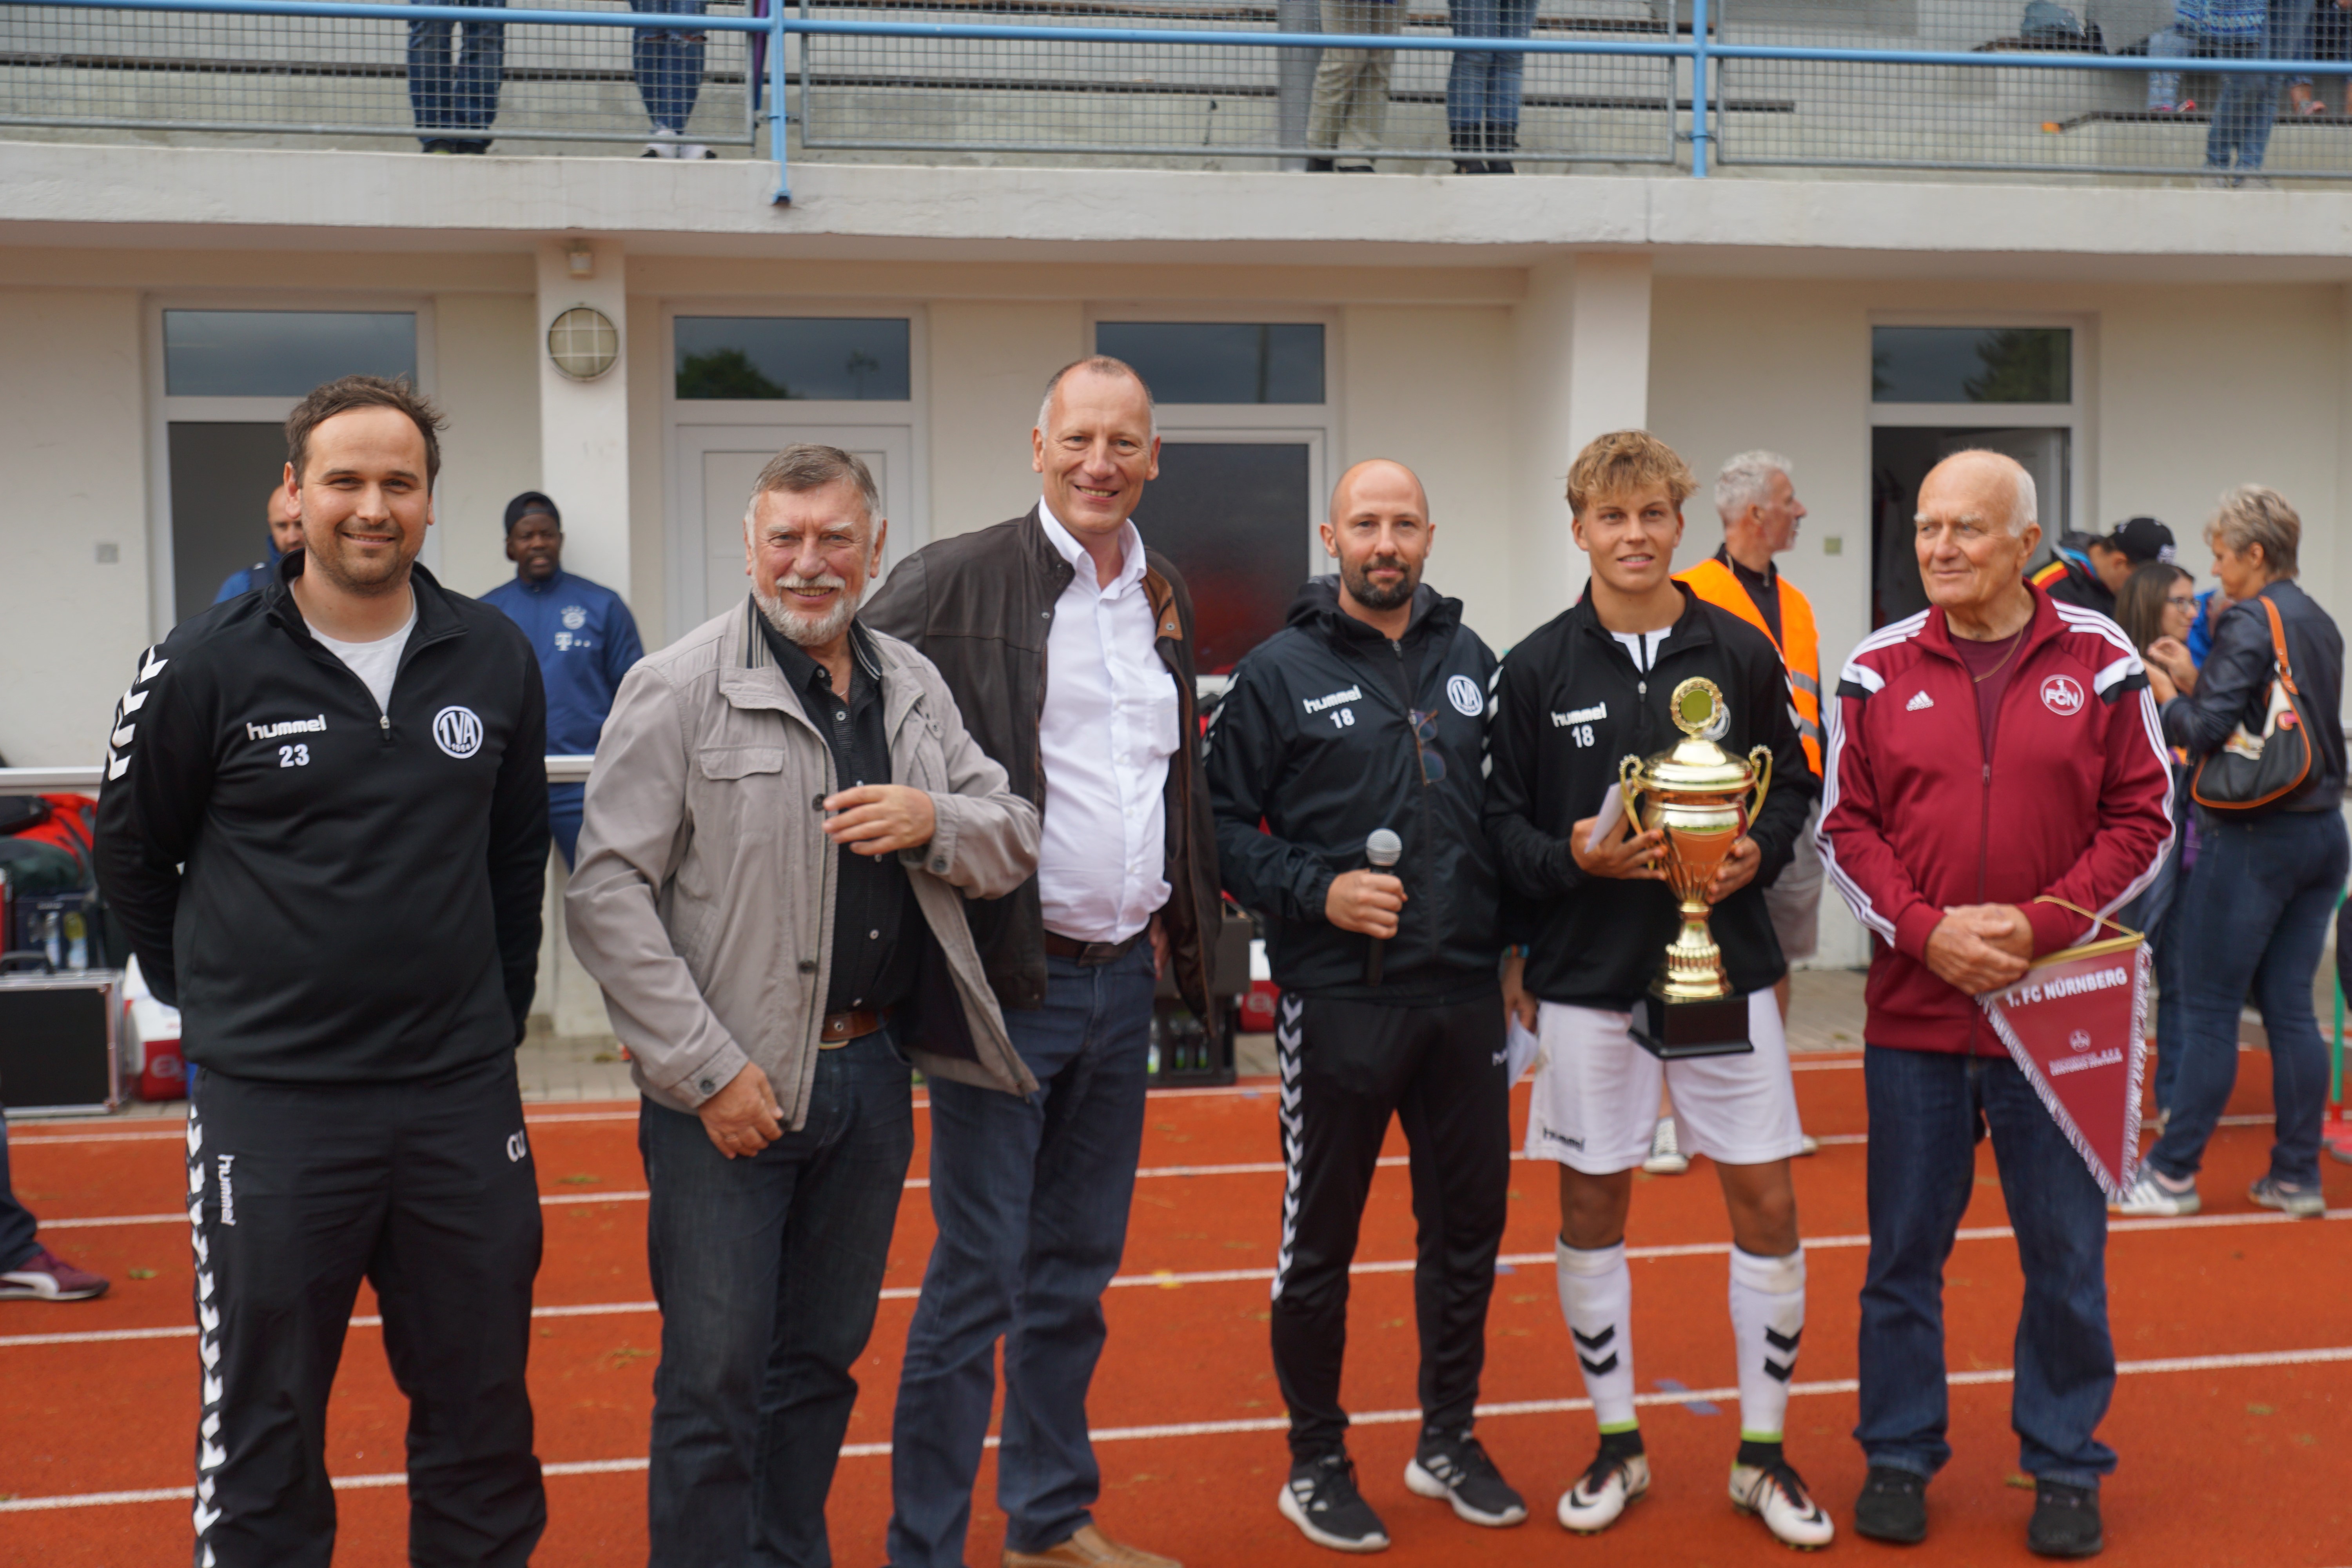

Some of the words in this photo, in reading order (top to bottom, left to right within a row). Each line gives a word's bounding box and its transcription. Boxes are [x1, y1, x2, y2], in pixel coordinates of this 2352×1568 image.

[1303, 684, 1362, 714] hummel
[2045, 689, 2078, 708] FCN
[246, 714, 327, 740] hummel
[1330, 708, 1355, 729] 18
[1551, 701, 1607, 728] hummel
[439, 711, 477, 748] TVA
[1572, 724, 1595, 748] 18
[279, 744, 310, 768] 23
[2006, 990, 2020, 1007] 1.
[2021, 985, 2042, 1005] FC
[2043, 966, 2128, 1000] NÜRNBERG
[218, 1154, 237, 1226] hummel
